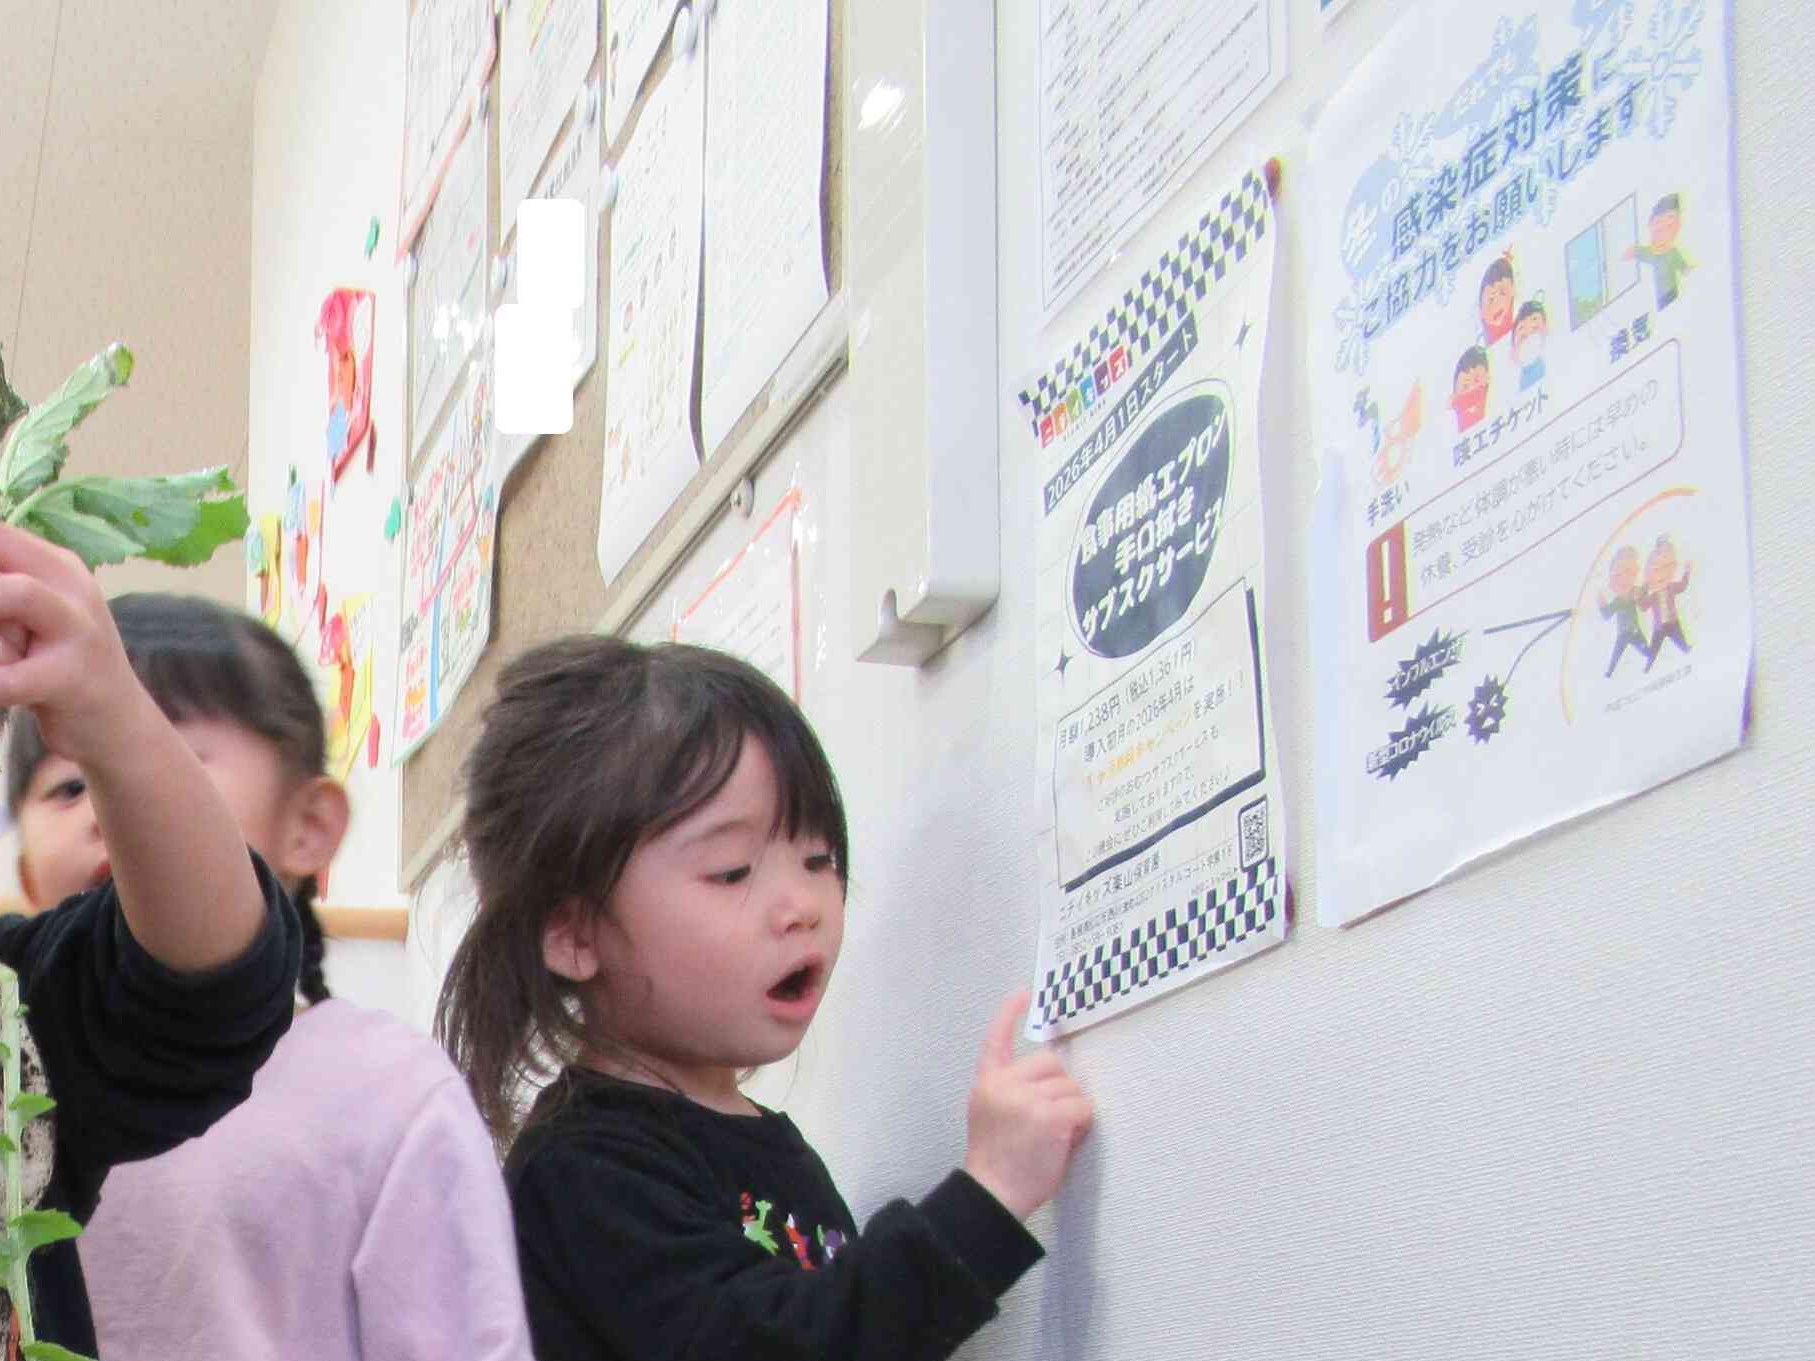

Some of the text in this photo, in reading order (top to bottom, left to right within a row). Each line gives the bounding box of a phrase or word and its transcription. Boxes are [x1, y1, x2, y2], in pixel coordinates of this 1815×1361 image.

[1363, 78, 1646, 339] ご協力をお願いします
[1047, 328, 1193, 509] 2026年4月1日スタート
[1080, 410, 1226, 566] 食事用紙エプロン
[1453, 388, 1548, 468] 咳エチケット
[1080, 497, 1223, 643] サブスクサービス
[1368, 480, 1410, 527] 手洗い
